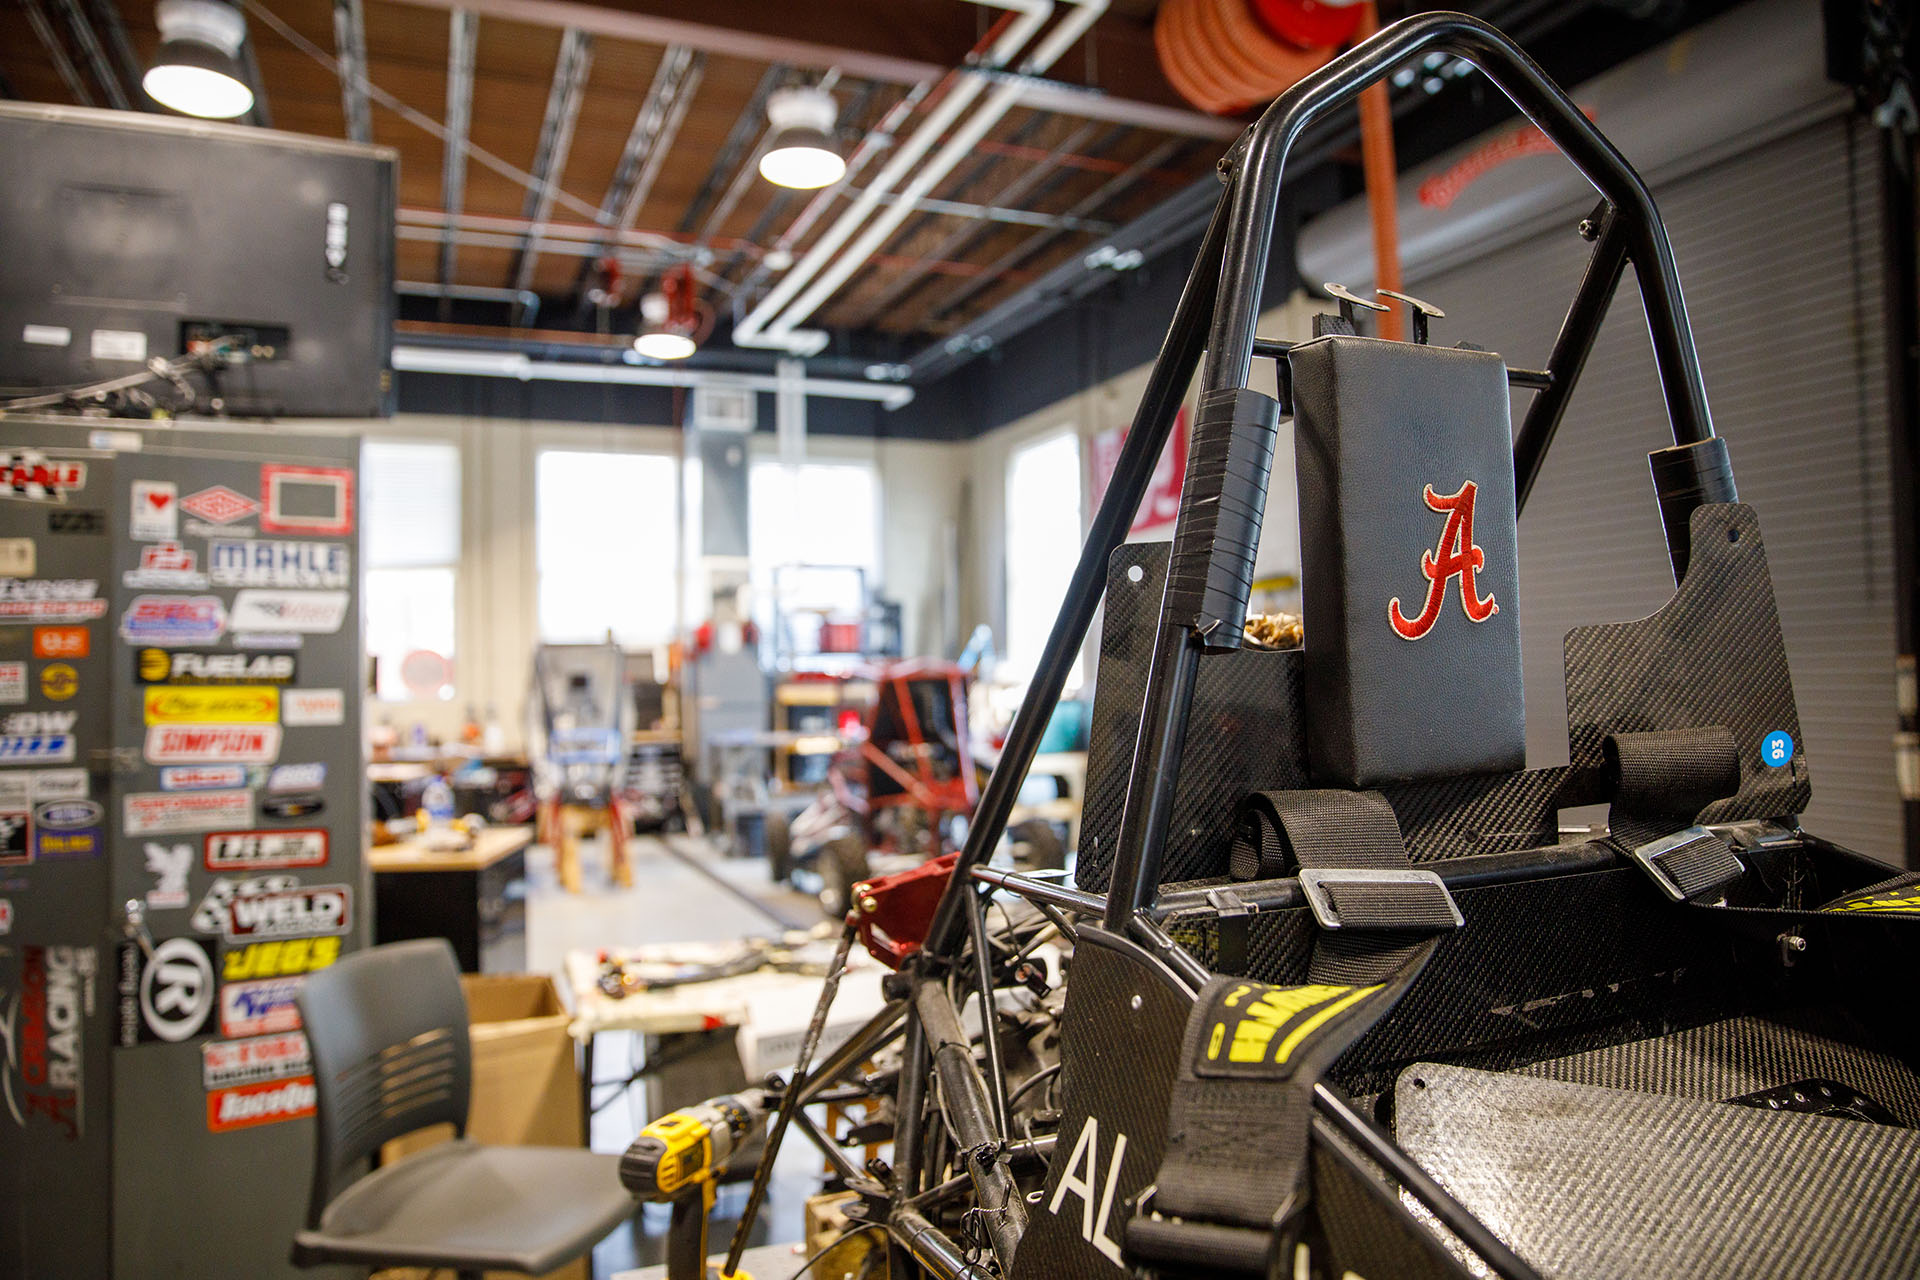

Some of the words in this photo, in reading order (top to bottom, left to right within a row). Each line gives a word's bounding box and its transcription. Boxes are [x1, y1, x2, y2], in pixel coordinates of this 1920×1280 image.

[213, 543, 342, 574] MAHLE
[1388, 480, 1496, 641] A
[171, 652, 295, 678] FUELAB
[161, 728, 265, 754] SIMPSON
[1771, 738, 1785, 760] 93
[235, 892, 343, 927] WELD
[223, 936, 342, 981] JEGS
[46, 946, 79, 1090] RACING
[1048, 1115, 1128, 1270] AL
